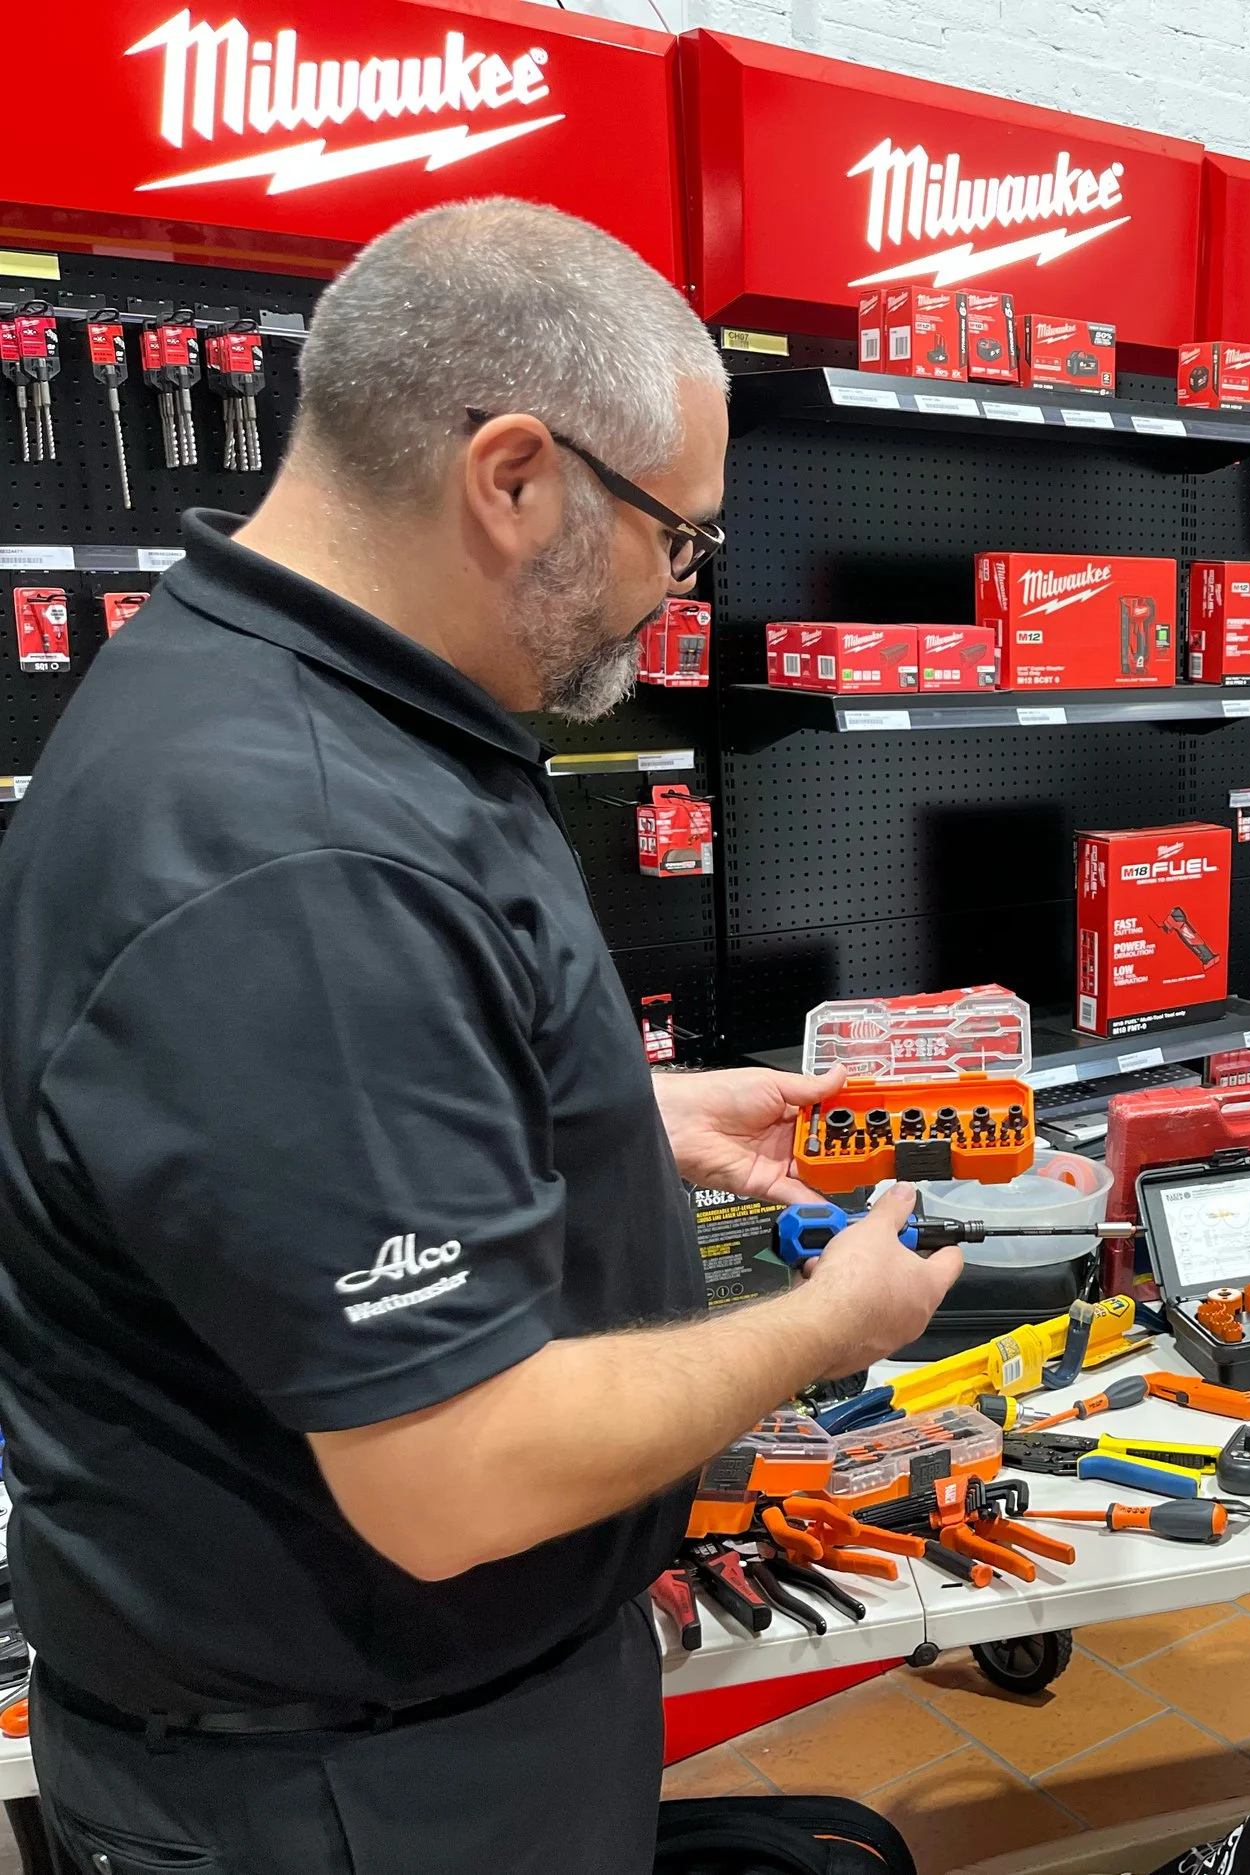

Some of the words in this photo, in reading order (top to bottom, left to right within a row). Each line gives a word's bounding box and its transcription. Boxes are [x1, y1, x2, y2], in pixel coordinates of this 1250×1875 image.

[124, 8, 549, 148] Milwaukee
[846, 136, 1125, 253] Milwaukee
[728, 331, 749, 340] CH07
[1036, 323, 1077, 338] Milwaukee
[1017, 563, 1112, 605] Milwaukee
[842, 632, 884, 648] Milwaukee
[924, 632, 964, 649] Milwaukee
[1019, 633, 1041, 641] M12
[1124, 866, 1148, 878] M18
[1152, 858, 1217, 876] FUEL
[1114, 918, 1137, 930] FAST
[1114, 927, 1143, 936] CUTTING
[1114, 940, 1146, 953] POWER
[1114, 949, 1154, 960] DEMOLITION
[1114, 964, 1134, 975] LOW
[1114, 976, 1148, 987] VIBRATION
[1113, 1027, 1126, 1035] M18
[696, 1194, 735, 1208] TOOLS
[335, 1233, 461, 1294] Alco
